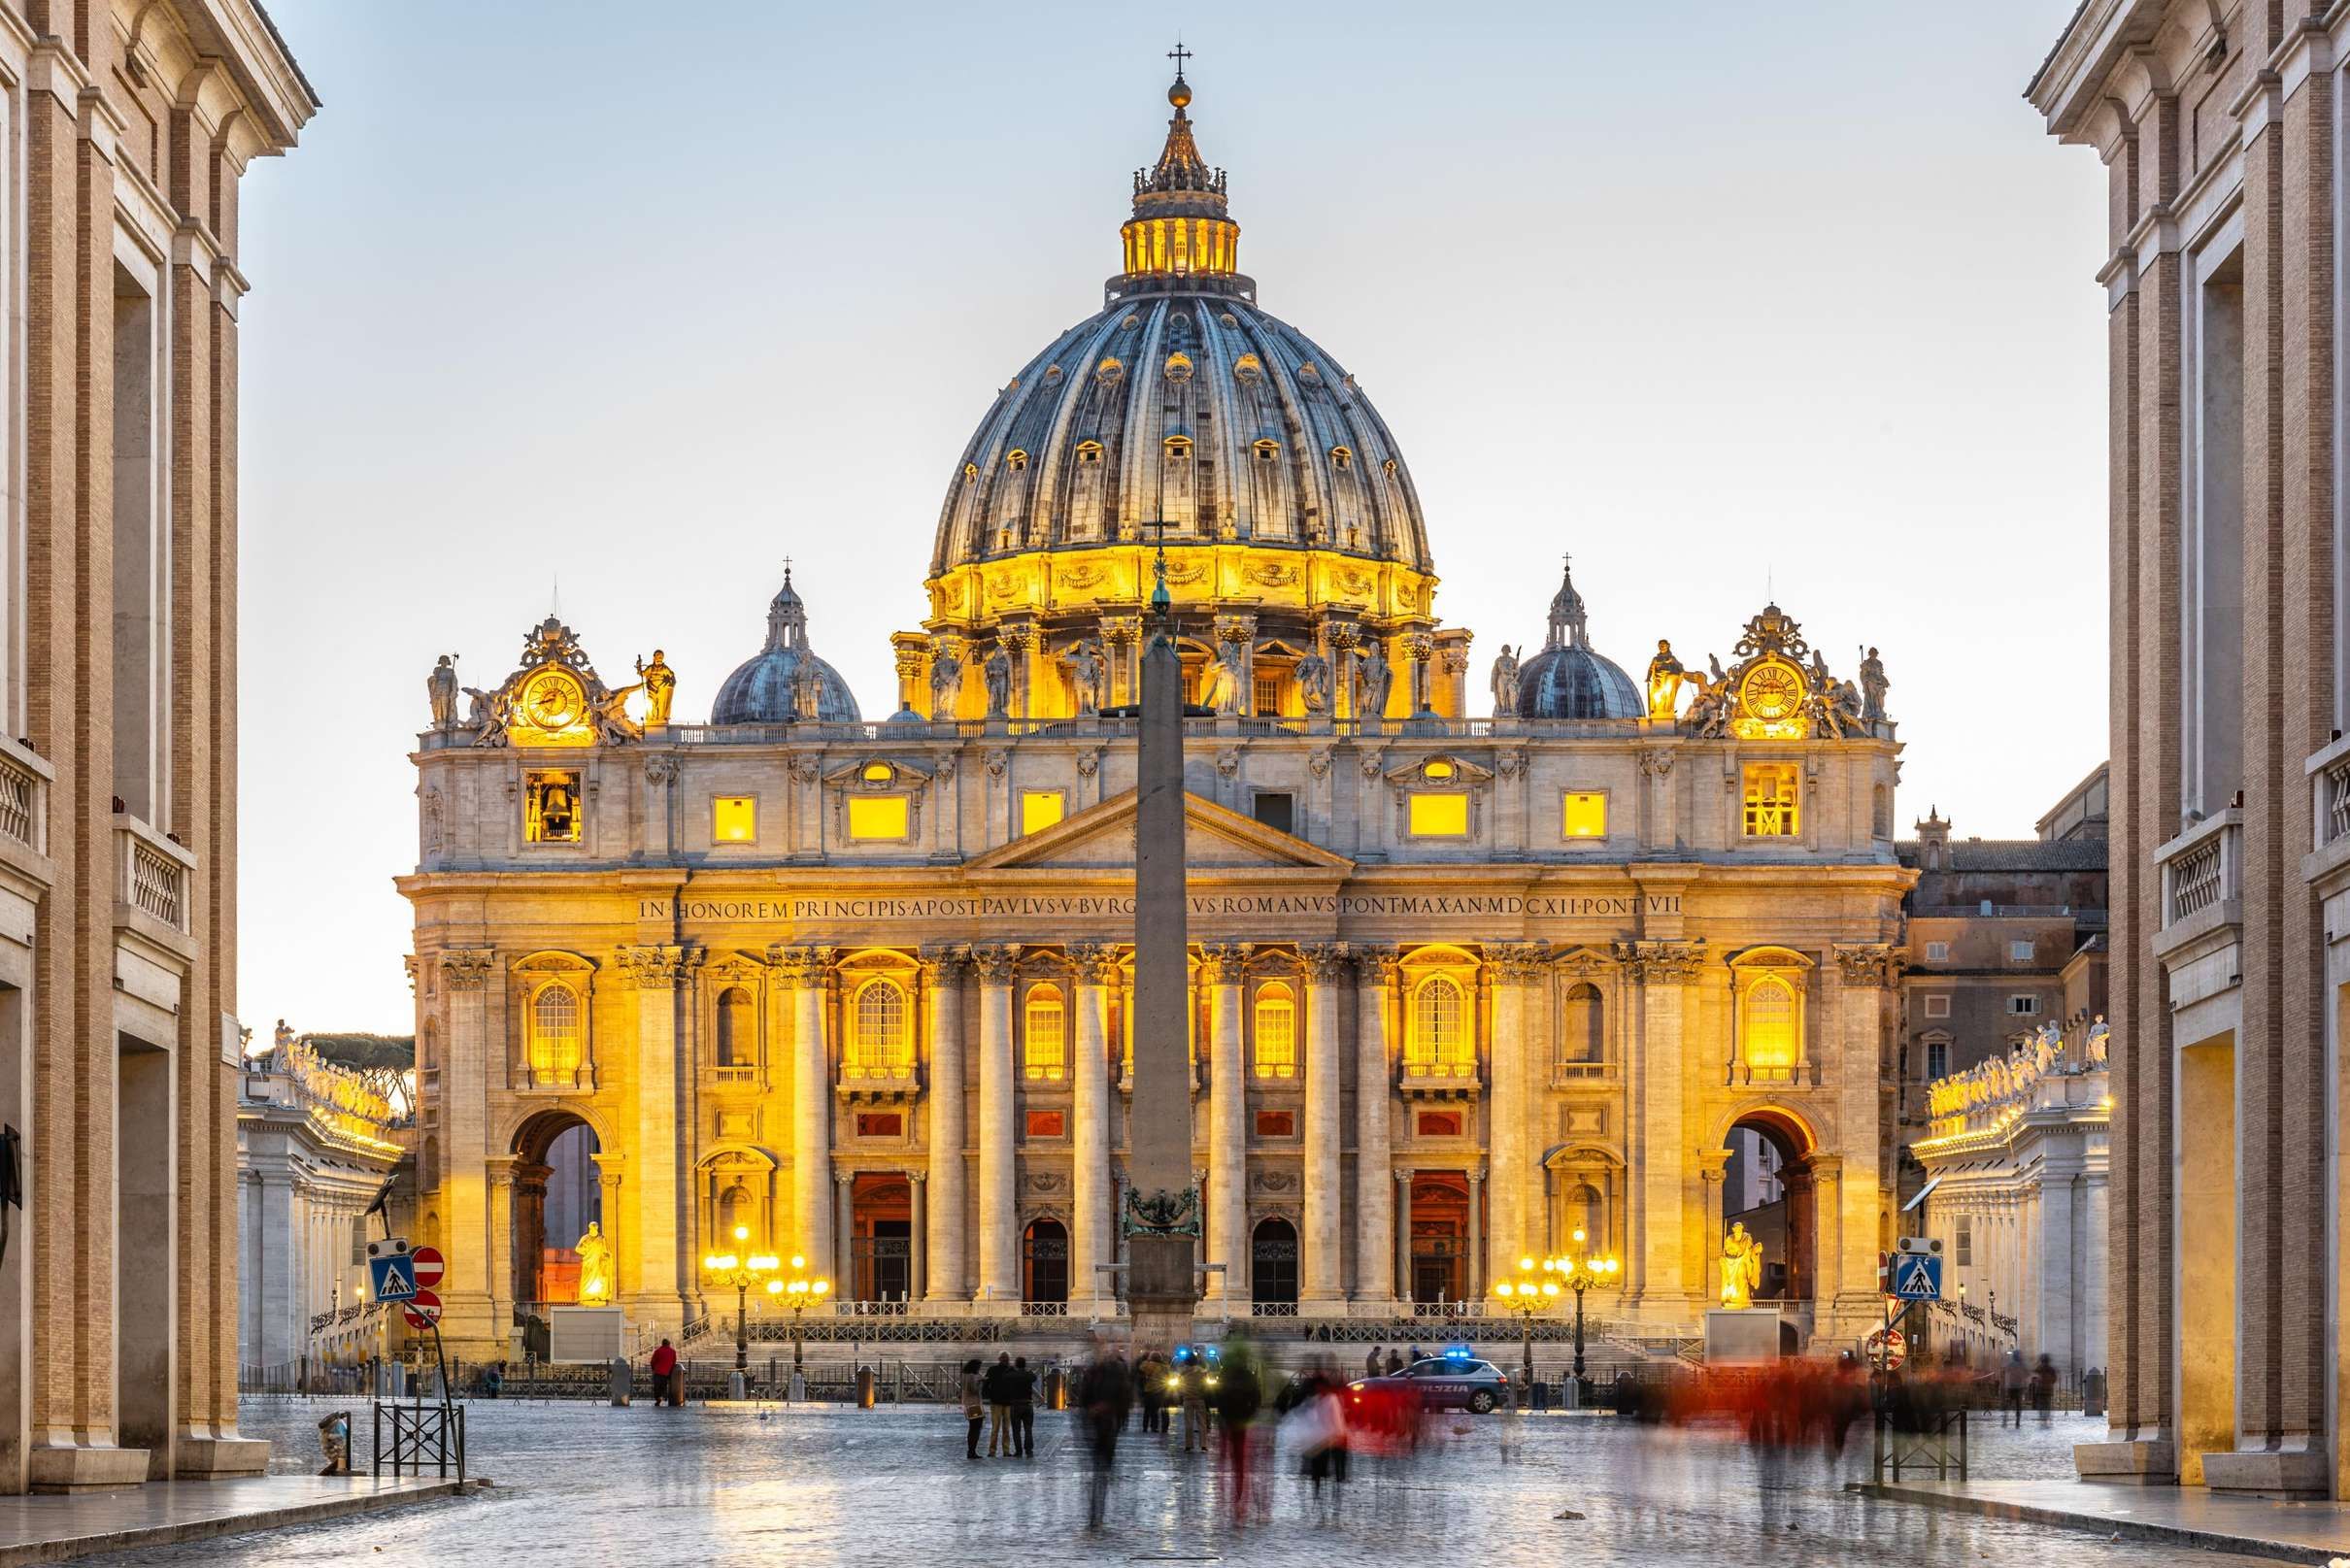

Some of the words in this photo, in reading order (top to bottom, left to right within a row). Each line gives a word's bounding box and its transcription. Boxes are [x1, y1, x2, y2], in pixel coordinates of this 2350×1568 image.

[640, 902, 664, 917] IN
[677, 902, 788, 918] HONOREM
[794, 901, 906, 917] PRINCIPIS
[911, 899, 979, 916] APOST
[983, 898, 1056, 914] PAVLVS
[1060, 898, 1073, 913] V
[1224, 897, 1335, 914] ROMANVS
[1342, 897, 1399, 914] PONT
[1401, 897, 1449, 914] MAX
[1452, 897, 1483, 914] AN
[1488, 897, 1575, 915] MDCXII
[1583, 898, 1641, 915] PONT
[1649, 896, 1679, 913] VII
[1407, 1385, 1469, 1393] OLIZIA
